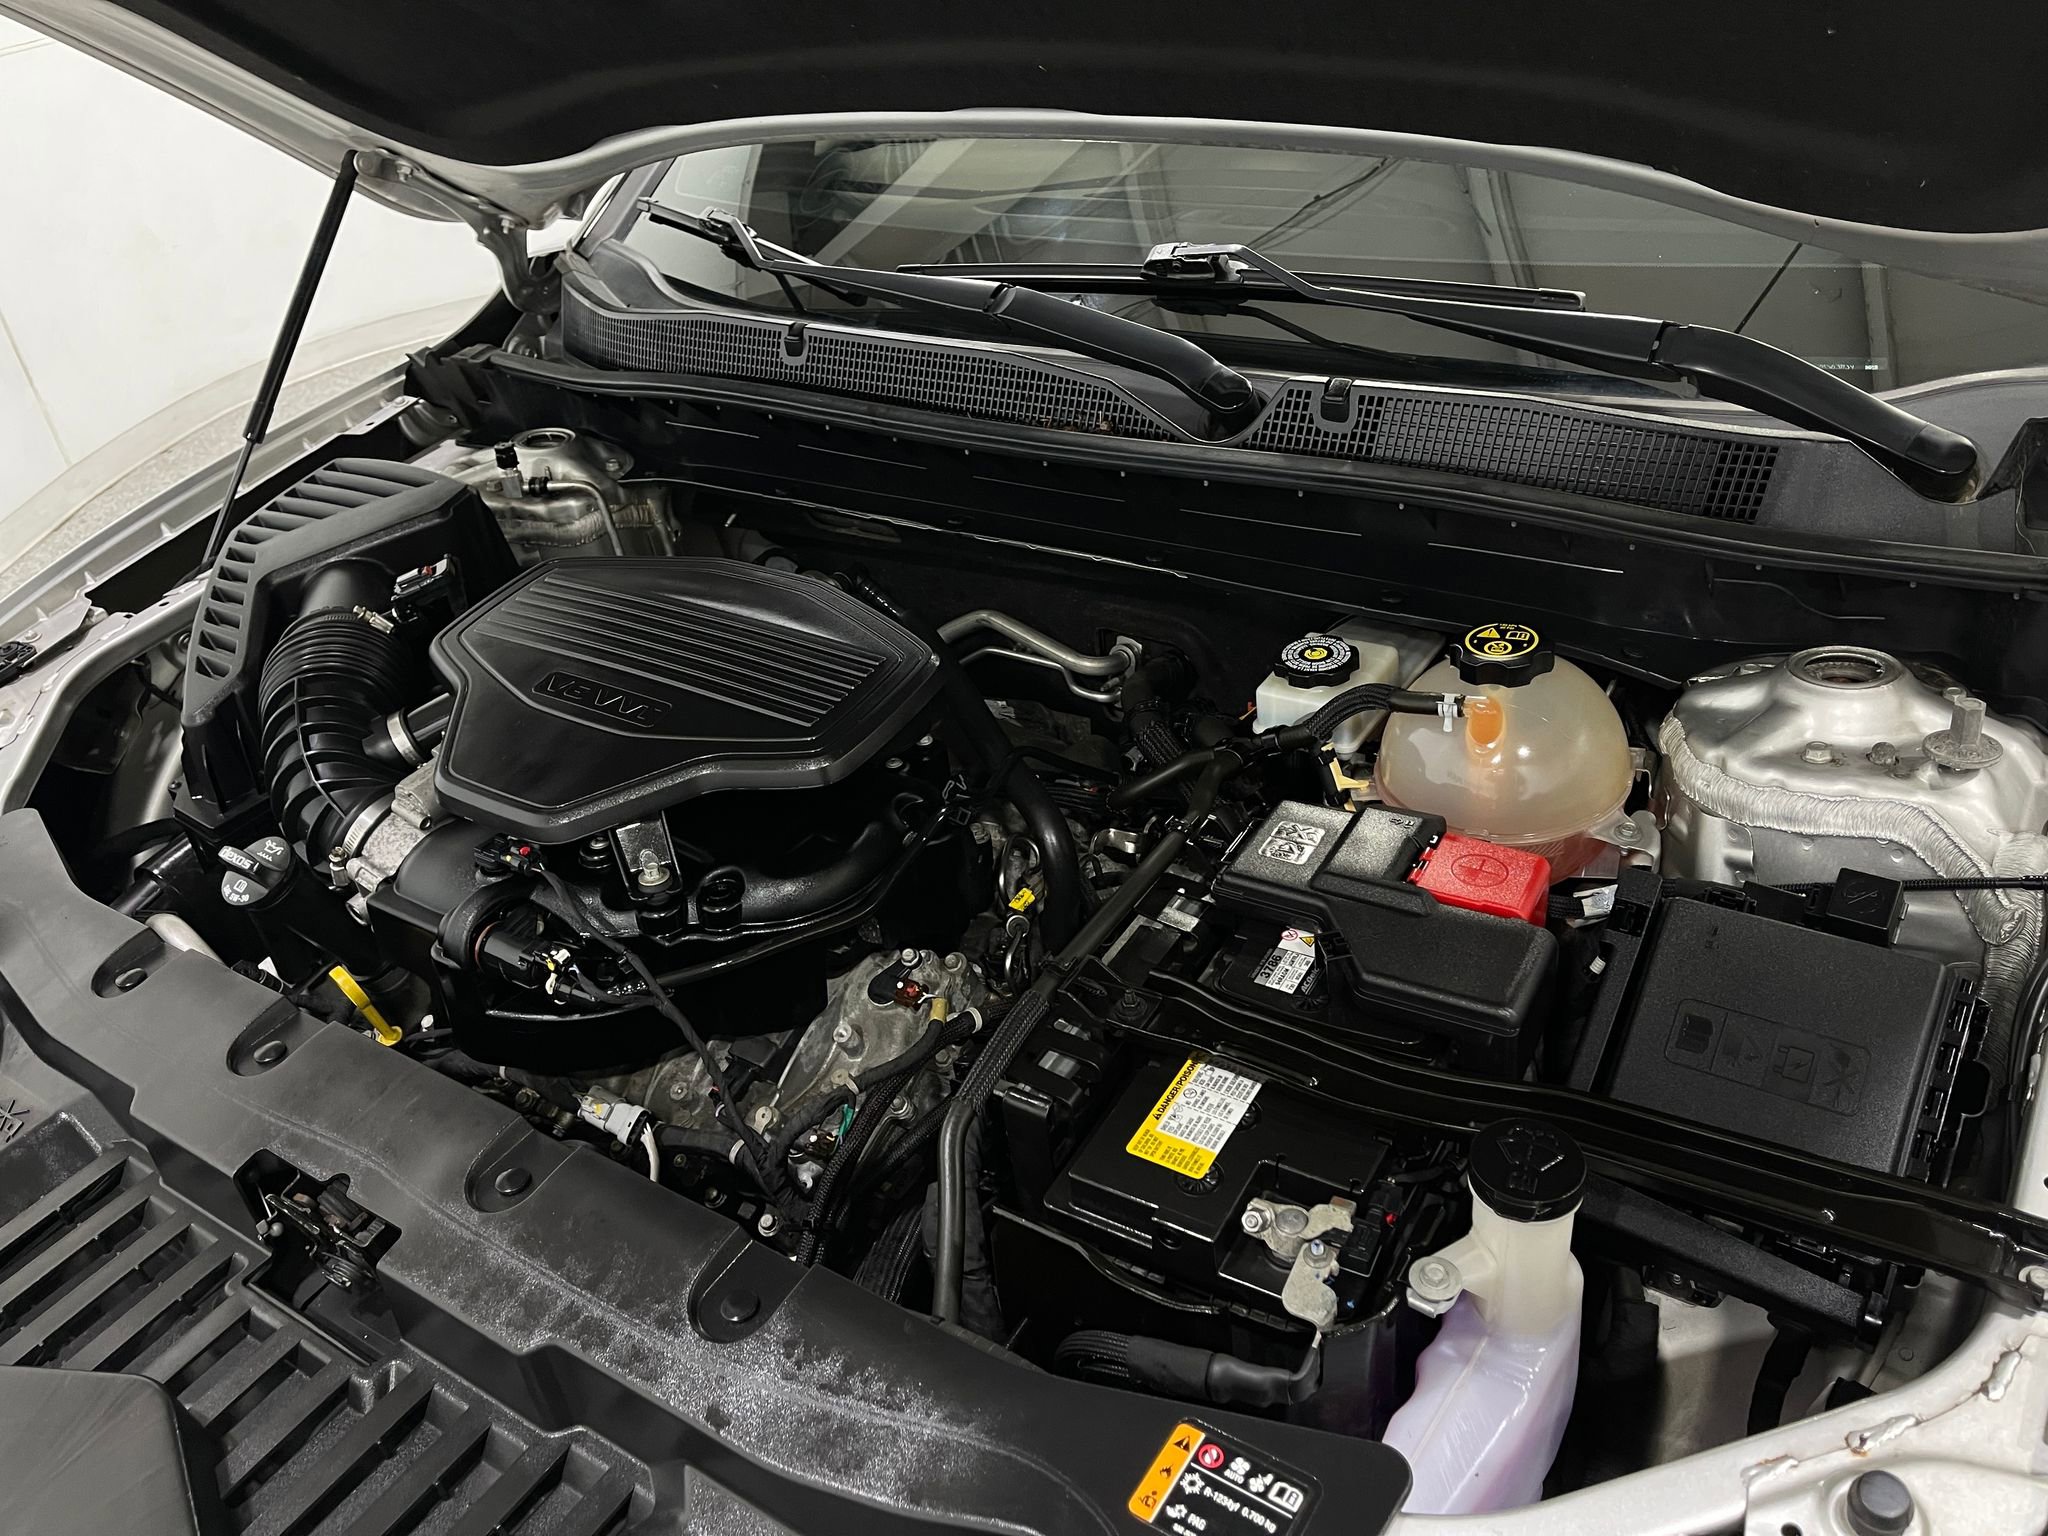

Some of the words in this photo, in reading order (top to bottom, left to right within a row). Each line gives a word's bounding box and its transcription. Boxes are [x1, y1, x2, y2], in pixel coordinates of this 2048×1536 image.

[1260, 954, 1282, 979] 3786
[1224, 1468, 1245, 1485] AUTO
[1187, 1513, 1207, 1531] PAG
[1241, 1505, 1265, 1526] 0.700
[1264, 1518, 1277, 1534] kg
